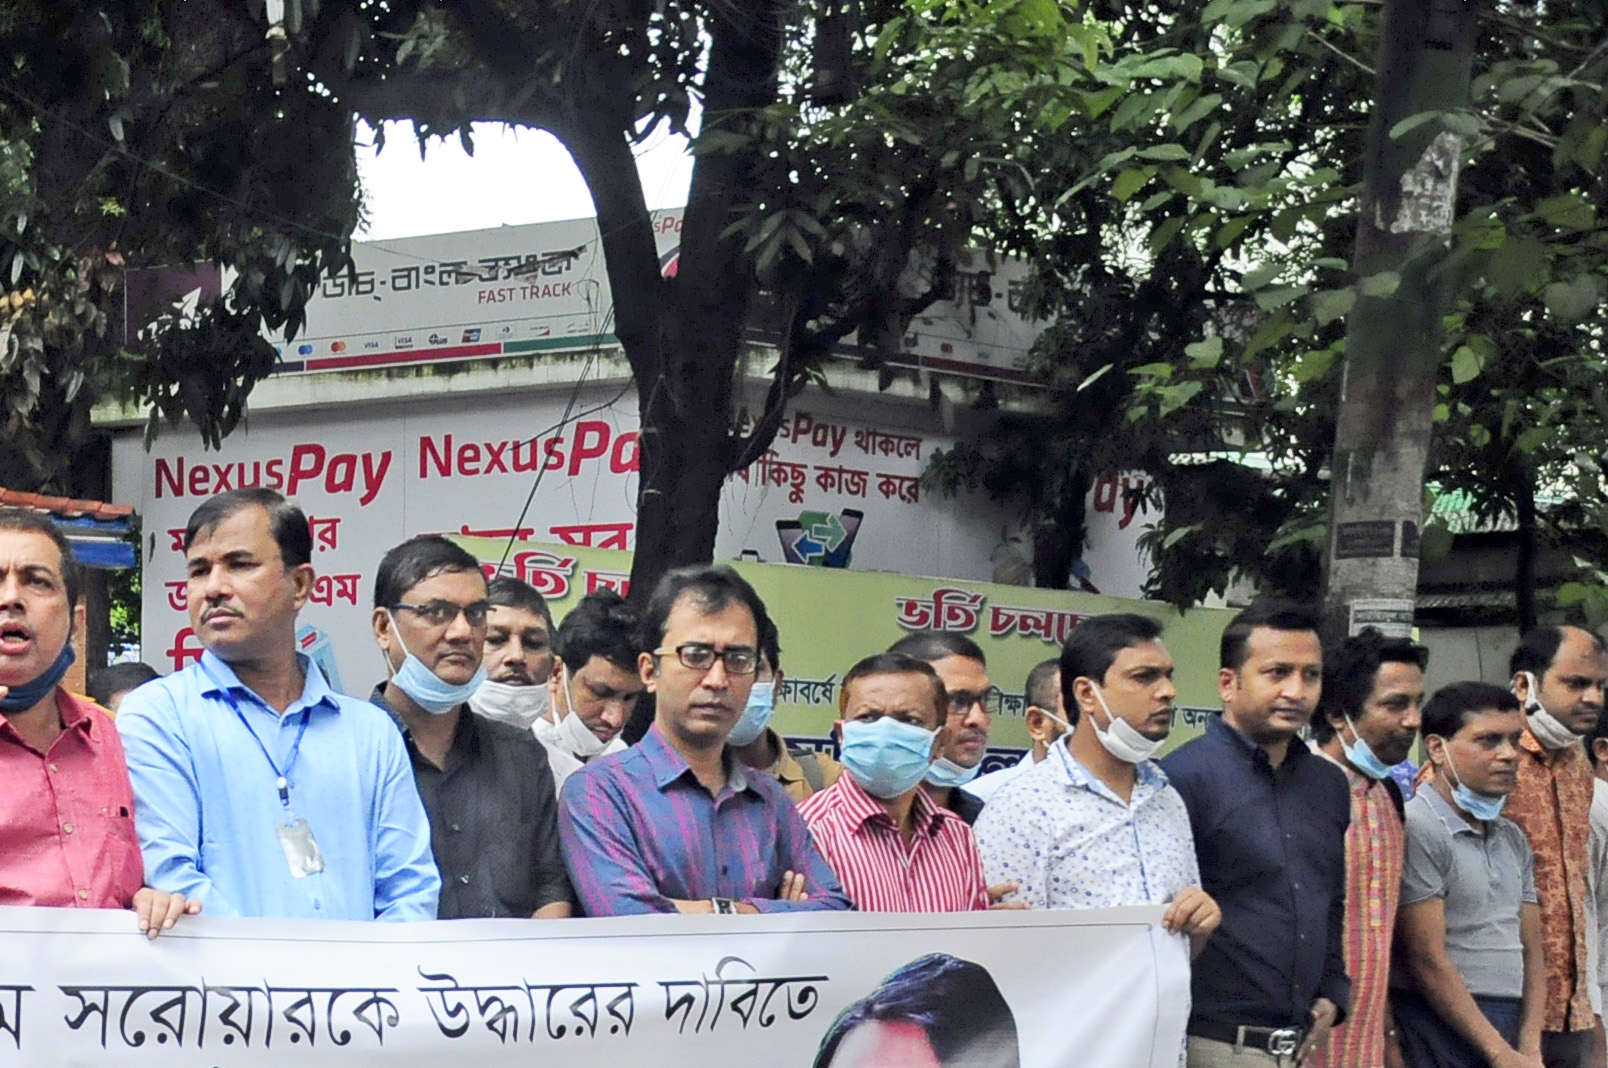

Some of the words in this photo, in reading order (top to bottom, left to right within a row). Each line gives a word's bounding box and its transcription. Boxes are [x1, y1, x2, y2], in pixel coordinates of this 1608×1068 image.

[477, 288, 517, 305] FAST
[520, 282, 572, 302] TRACK
[418, 420, 640, 480] NexusPa
[854, 428, 923, 461] থাকলে
[154, 443, 392, 508] NexusPay
[813, 465, 870, 499] কাজ
[875, 472, 923, 504] করে
[896, 588, 986, 631] ভর্তি
[57, 977, 398, 1049] সরোয়ারকে
[417, 964, 639, 1044] উদ্ধারের
[657, 957, 830, 1035] দাবিতে
